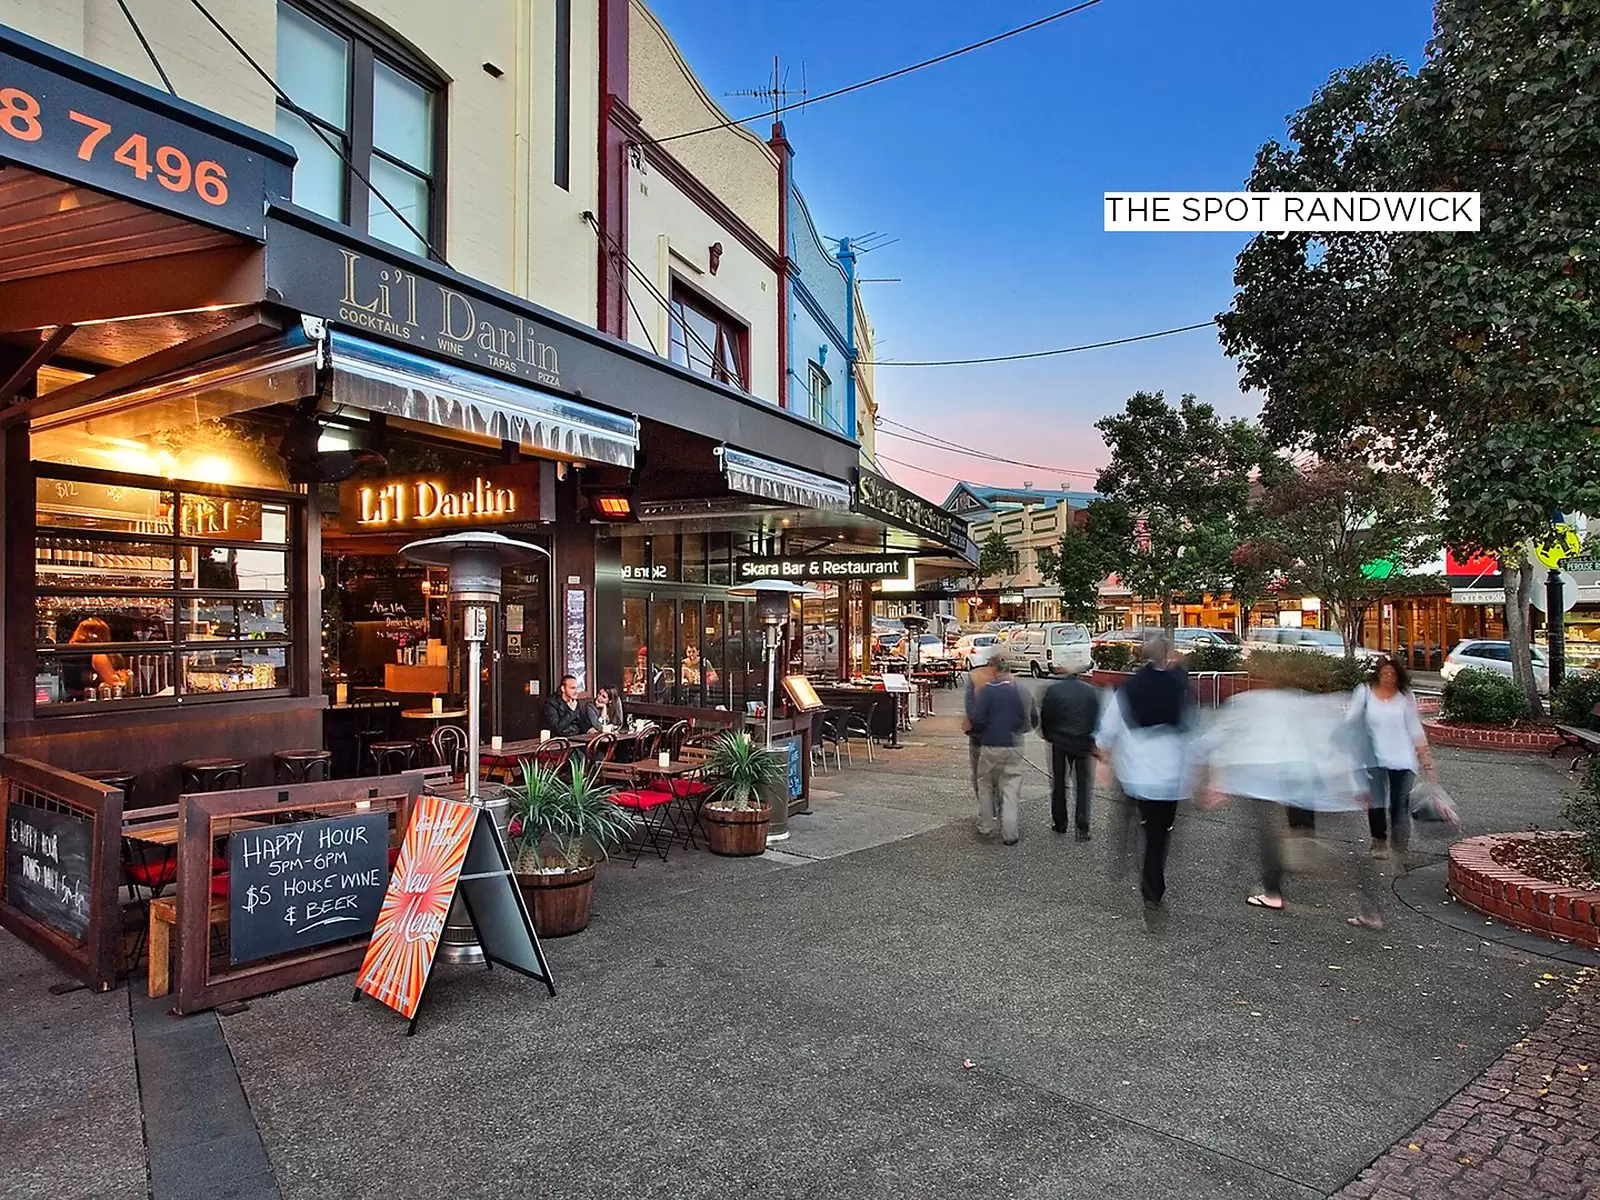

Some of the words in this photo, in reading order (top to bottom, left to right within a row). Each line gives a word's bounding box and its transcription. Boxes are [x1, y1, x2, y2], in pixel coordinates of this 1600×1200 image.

[0, 88, 43, 142] 8
[68, 110, 229, 206] 7496
[338, 249, 419, 327] Li'l
[438, 286, 560, 374] Darlin
[339, 307, 411, 339] COCKTAILS
[437, 338, 464, 357] WINE
[487, 354, 517, 373] TAPAS
[537, 372, 561, 388] PIZZA
[55, 481, 79, 499] $12
[356, 484, 404, 524] Li'l
[412, 476, 515, 520] Darlin
[742, 562, 779, 576] Skara
[782, 561, 805, 575] Bar
[809, 561, 820, 574] &
[823, 559, 899, 574] Restaurant
[1567, 562, 1593, 571] PEROUSE
[242, 830, 305, 868] HAPPY
[319, 826, 368, 848] HOUR
[268, 851, 348, 876] 5PM-6PM
[241, 884, 272, 914] $5
[283, 873, 338, 896] HOUSE
[341, 869, 380, 889] WINE
[397, 860, 434, 894] New
[284, 905, 297, 926] &
[306, 895, 358, 920] BEER
[393, 896, 442, 941] Menu
